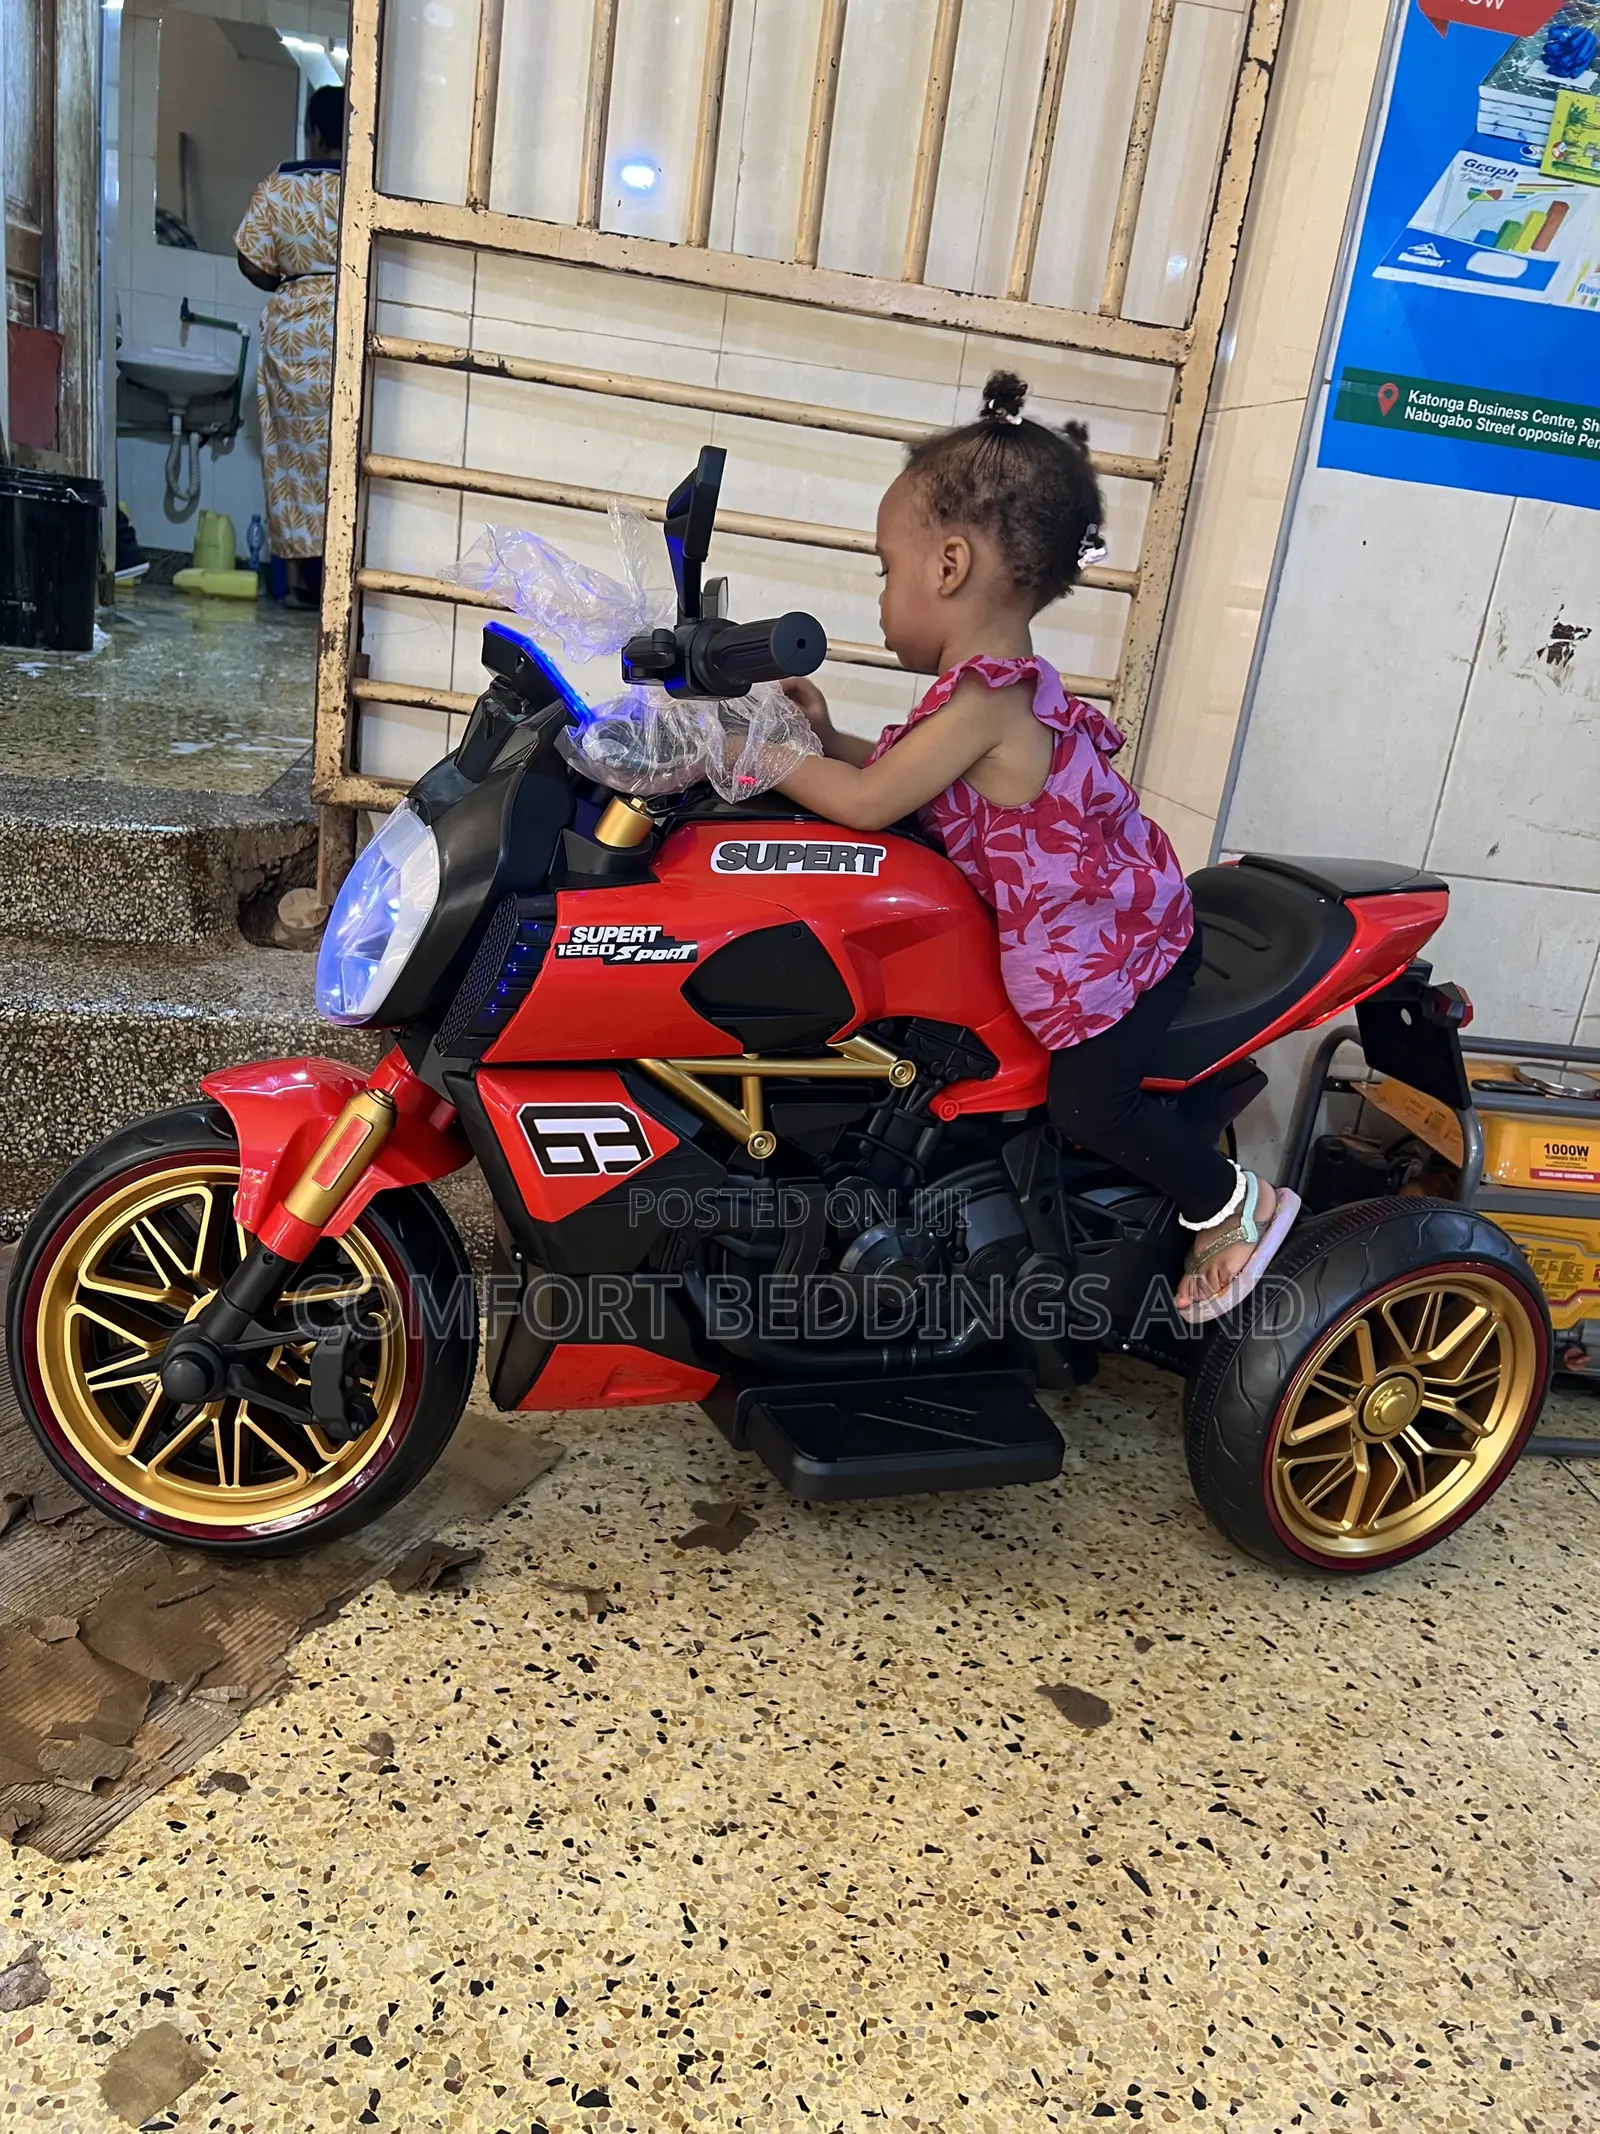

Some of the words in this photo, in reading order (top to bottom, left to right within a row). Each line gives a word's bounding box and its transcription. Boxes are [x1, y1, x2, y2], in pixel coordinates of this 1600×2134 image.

[1463, 158, 1519, 178] Graph
[1408, 389, 1464, 413] Katonga
[1467, 399, 1529, 422] Business
[1532, 409, 1578, 431] Centre,
[1404, 406, 1473, 429] Nabugabo
[1475, 417, 1516, 436] Street
[1518, 426, 1575, 445] opposite
[715, 842, 885, 874] SUPERT
[571, 926, 662, 944] SUPERT
[557, 944, 614, 956] 1260
[524, 1107, 652, 1174] 63
[1543, 1143, 1589, 1157] 1000W
